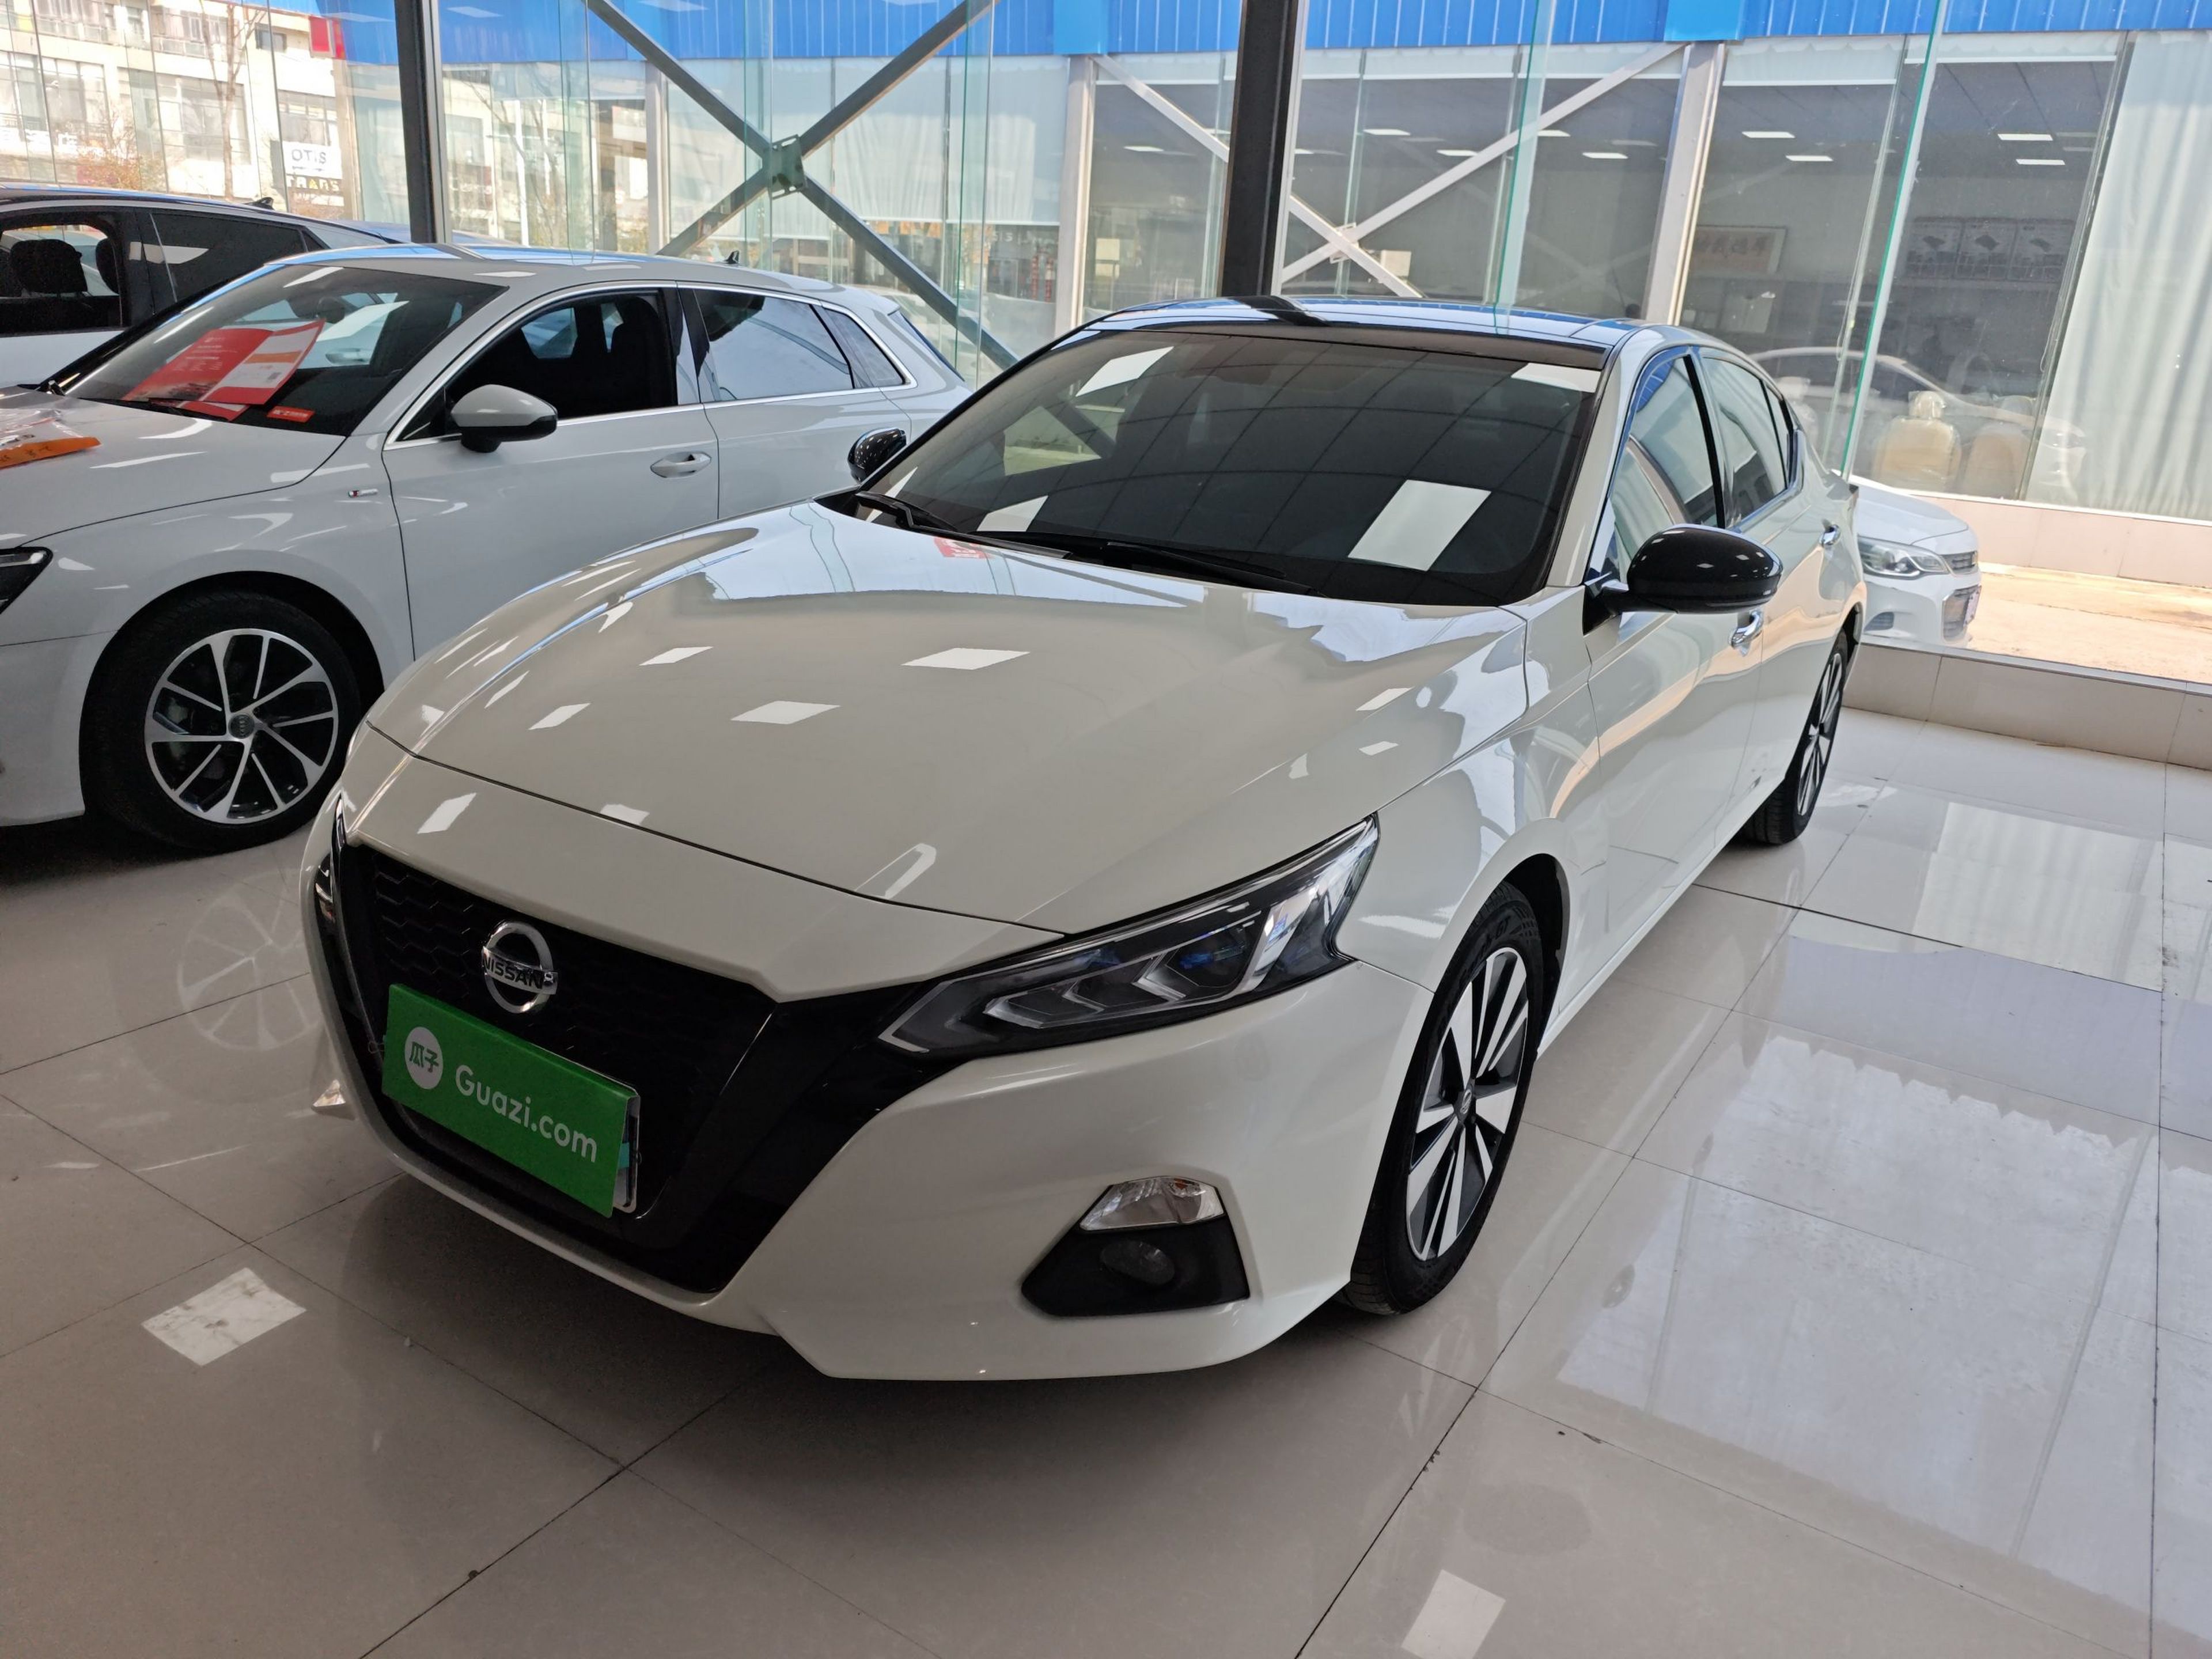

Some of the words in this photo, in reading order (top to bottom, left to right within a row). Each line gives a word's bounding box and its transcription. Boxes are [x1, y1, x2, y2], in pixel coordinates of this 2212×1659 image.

[483, 953, 543, 990] NISSAN
[409, 1041, 439, 1073] 瓜子
[456, 1065, 597, 1163] Guazi.com
